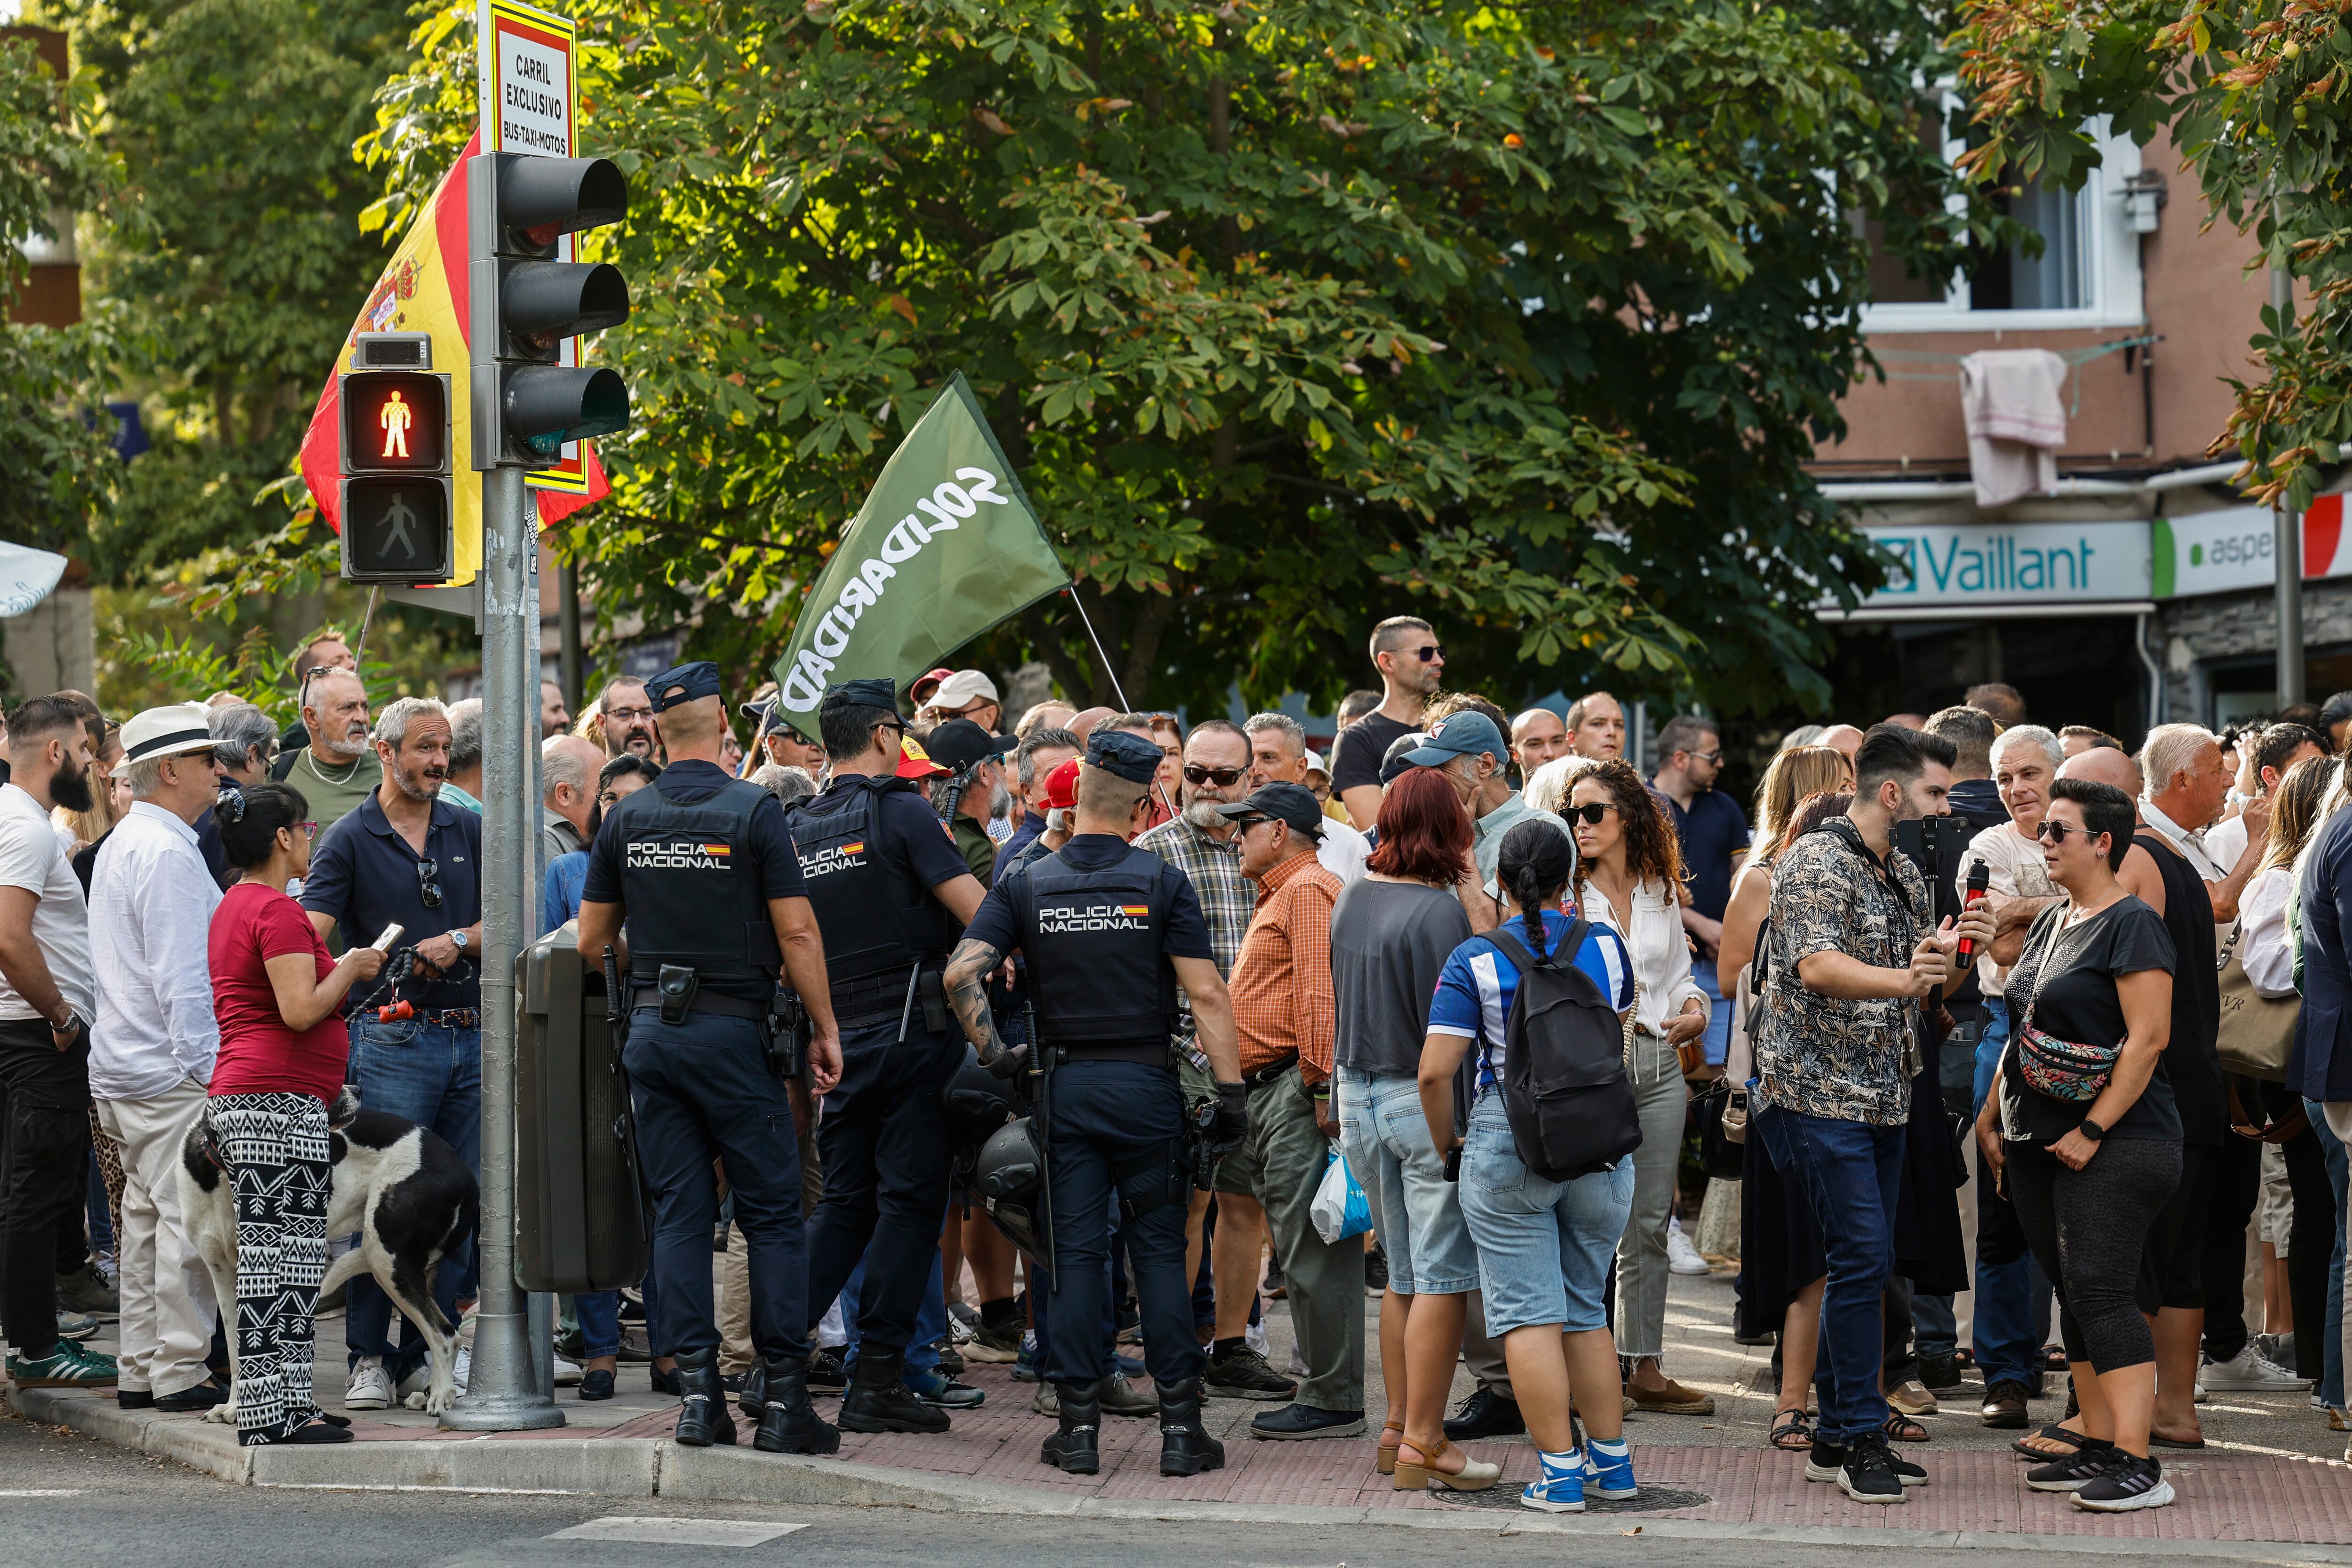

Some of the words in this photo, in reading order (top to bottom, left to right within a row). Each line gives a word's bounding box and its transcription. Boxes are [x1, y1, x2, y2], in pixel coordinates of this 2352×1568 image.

[516, 54, 550, 85] CARRIL
[507, 83, 561, 120] EXCLUSIVO
[504, 120, 565, 155] BUS-TAXI-MOTOS
[1921, 536, 2094, 592] Vaillant
[628, 856, 731, 869] NACIONAL
[803, 856, 867, 879] CIONAL
[1040, 918, 1149, 933] NACIONAL
